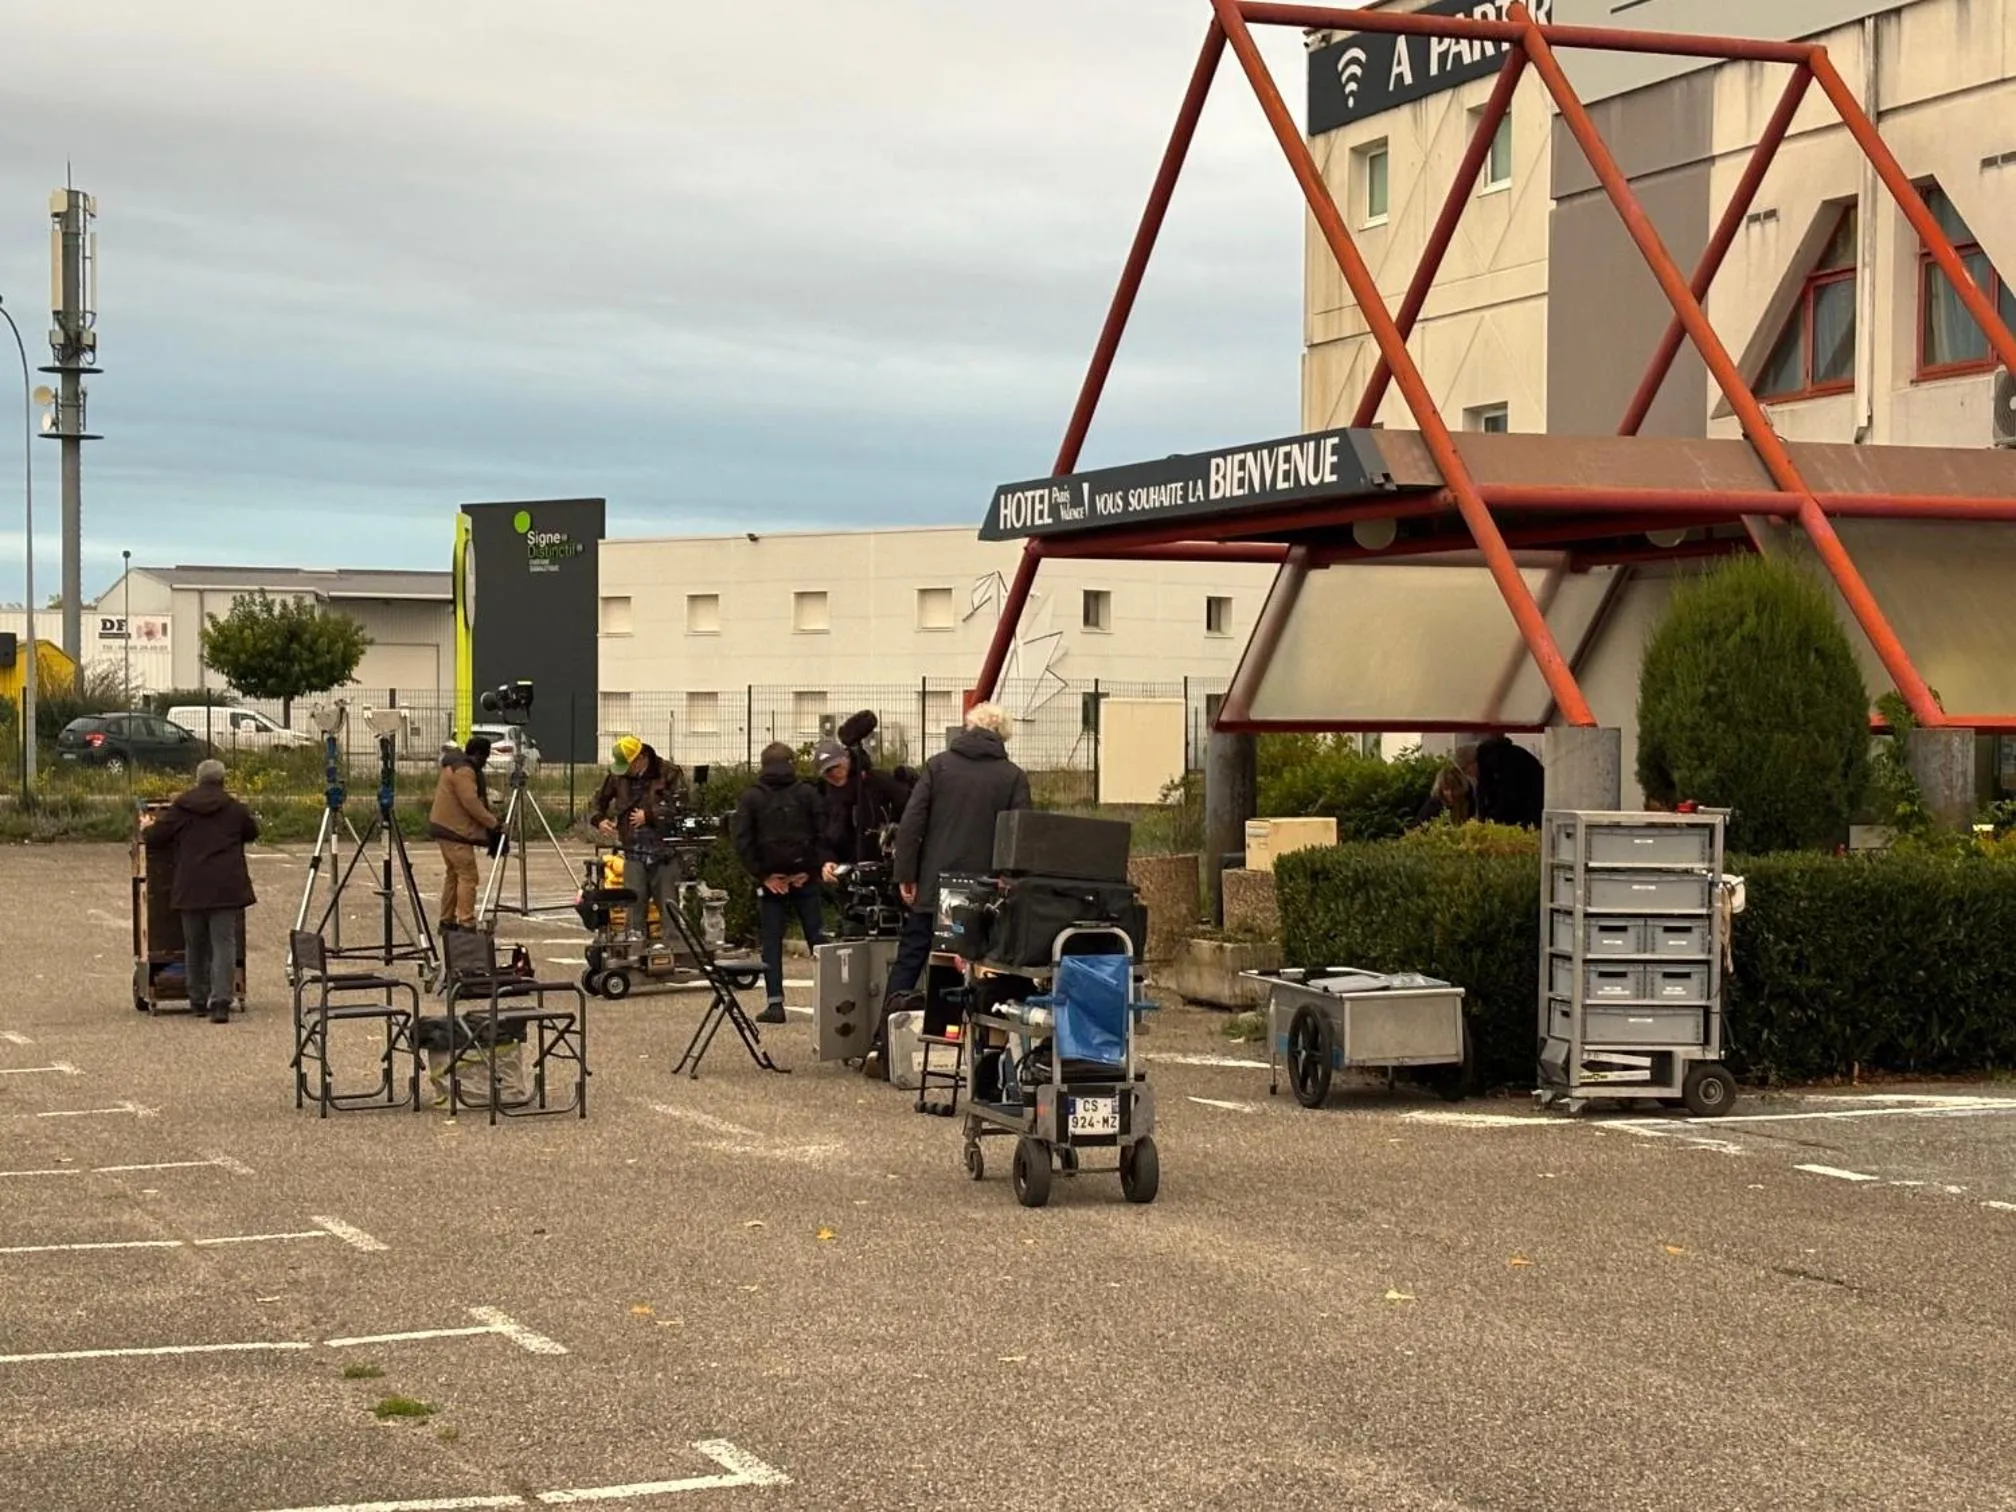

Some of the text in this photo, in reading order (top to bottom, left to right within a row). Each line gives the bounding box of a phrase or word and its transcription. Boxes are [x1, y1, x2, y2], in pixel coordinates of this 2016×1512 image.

[1388, 34, 1414, 92] A
[1095, 437, 1340, 516] VOUS SOUHAITE LA BIENVENUE
[999, 488, 1054, 530] HOTEL
[527, 530, 561, 548] Signe
[1071, 1115, 1118, 1129] 924-MZ
